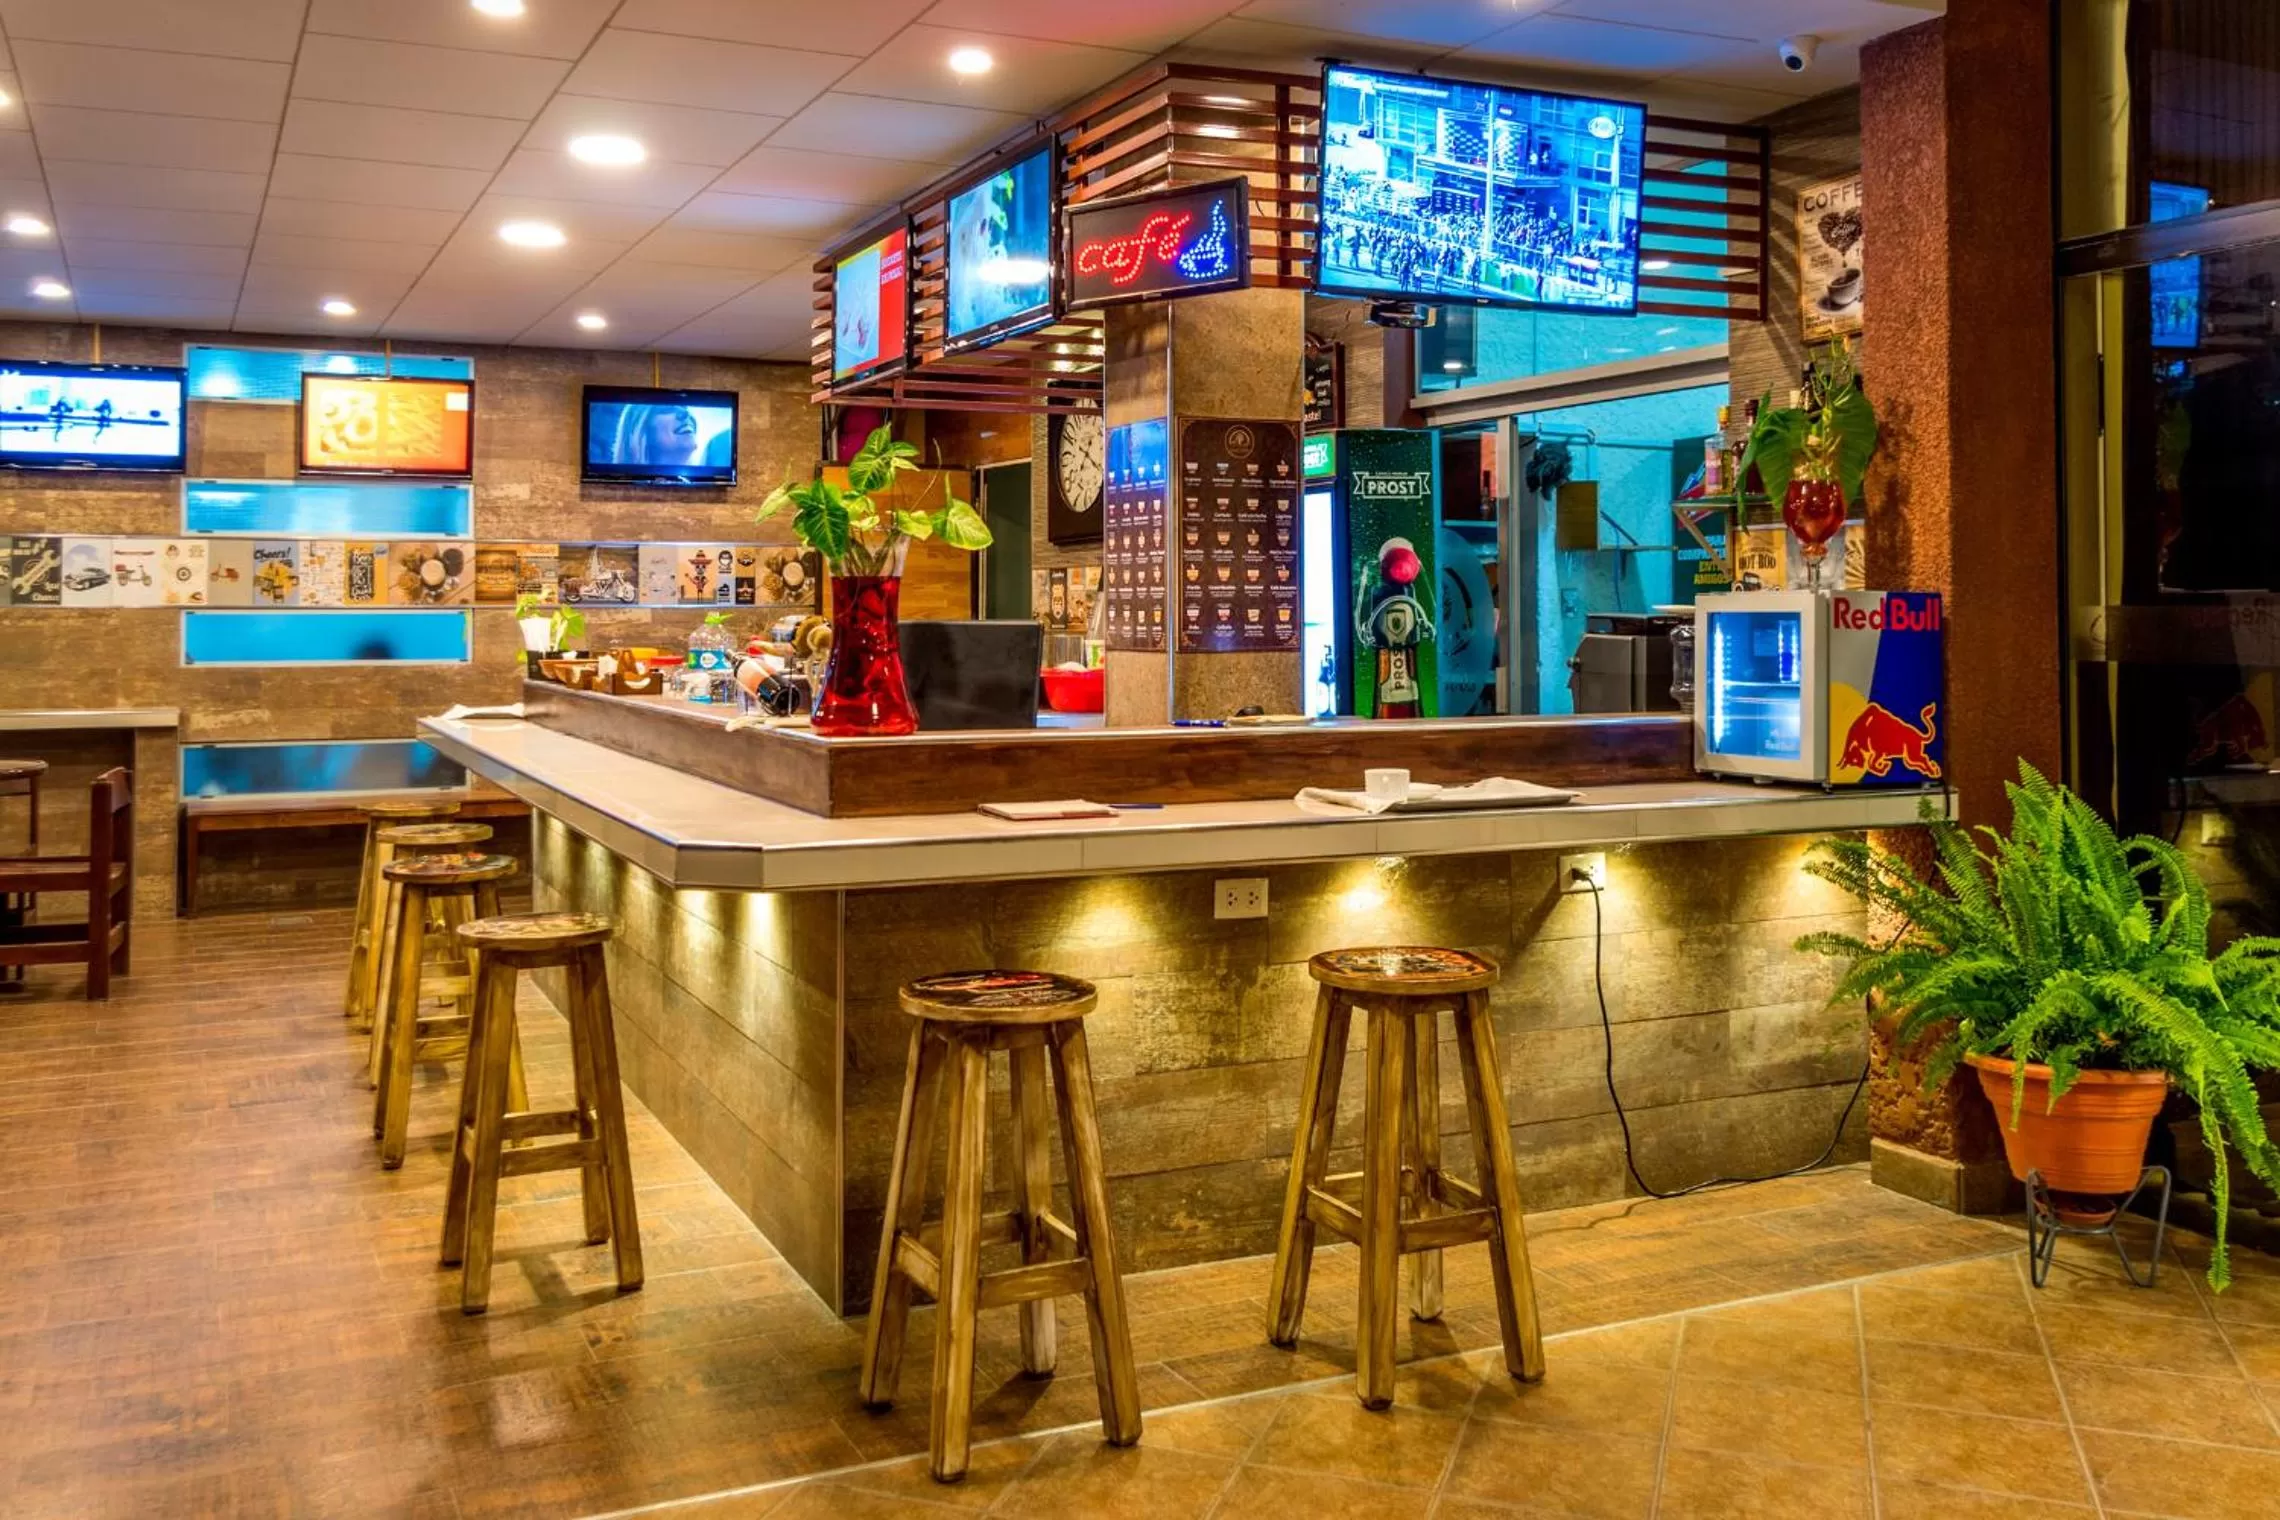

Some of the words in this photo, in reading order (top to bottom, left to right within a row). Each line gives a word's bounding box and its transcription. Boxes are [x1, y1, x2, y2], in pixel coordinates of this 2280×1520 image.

[1367, 480, 1417, 495] PROST
[254, 547, 291, 560] Cheers!
[1833, 597, 1885, 629] Red
[1890, 598, 1941, 631] Bull
